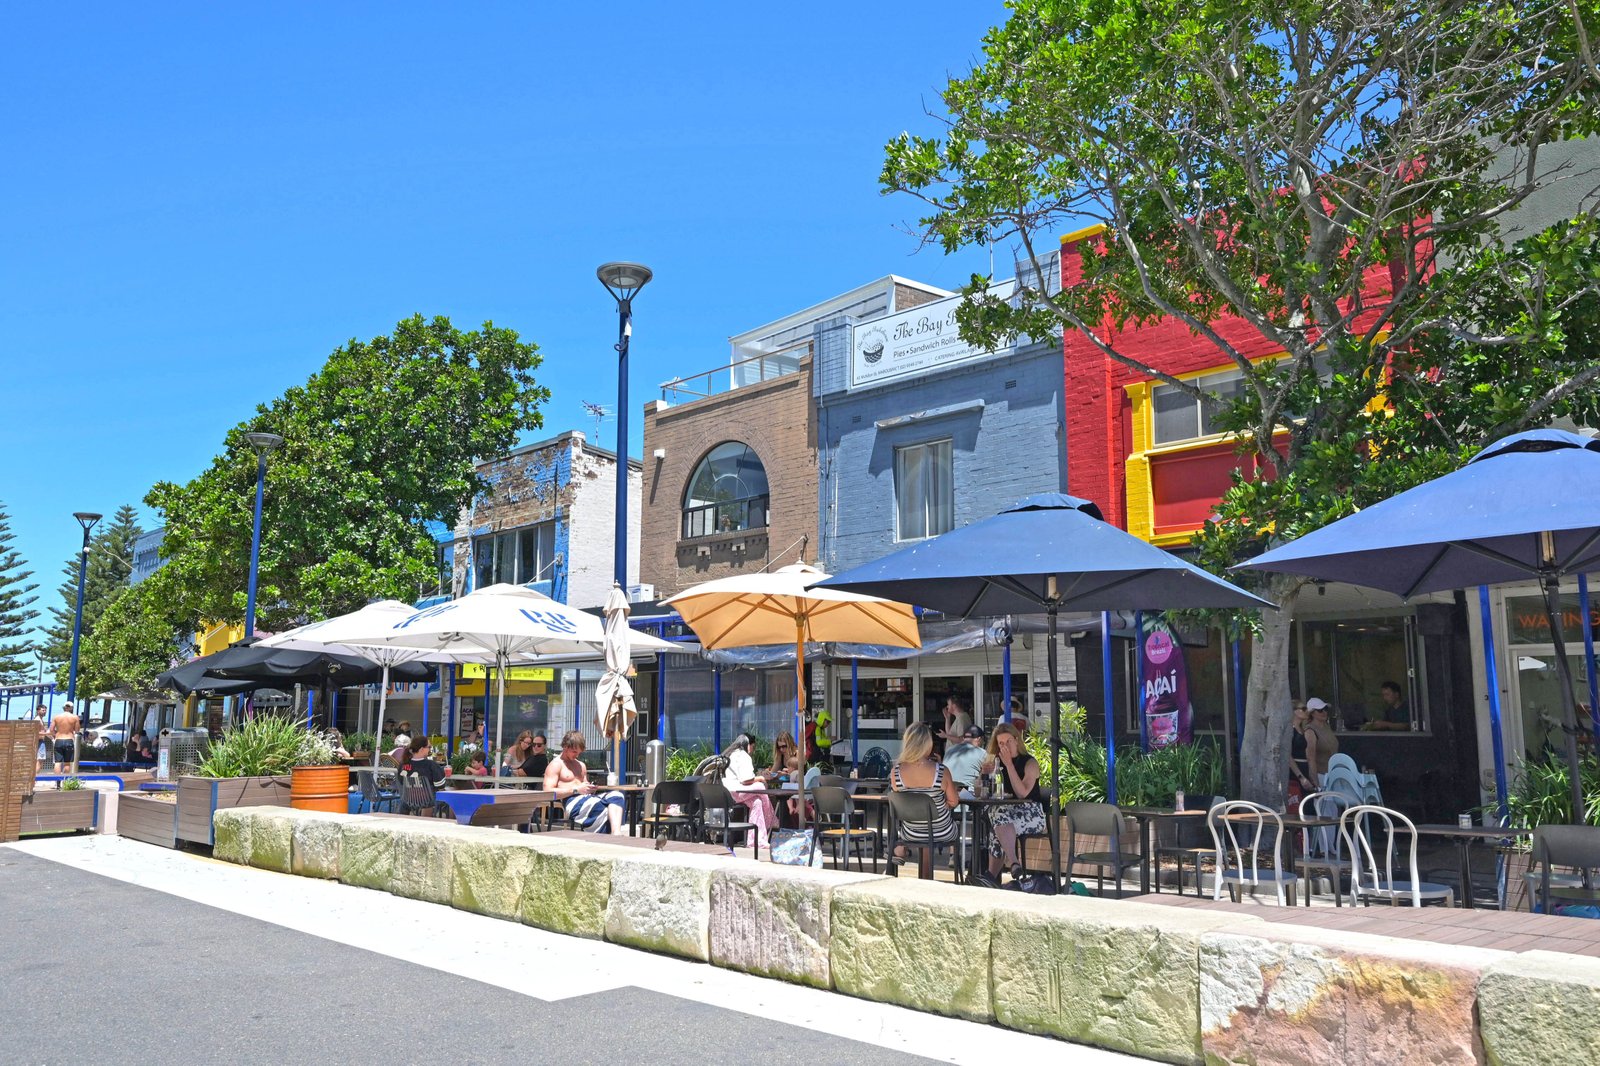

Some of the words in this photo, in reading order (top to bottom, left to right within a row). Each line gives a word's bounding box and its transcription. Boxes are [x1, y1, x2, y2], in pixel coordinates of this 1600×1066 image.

[894, 321, 914, 341] The
[916, 317, 943, 336] Bay
[893, 350, 906, 358] Pies
[909, 341, 940, 355] Sandwich
[941, 336, 956, 346] Rolls
[1519, 609, 1600, 629] WAING
[1146, 669, 1177, 702] AÇAÍ
